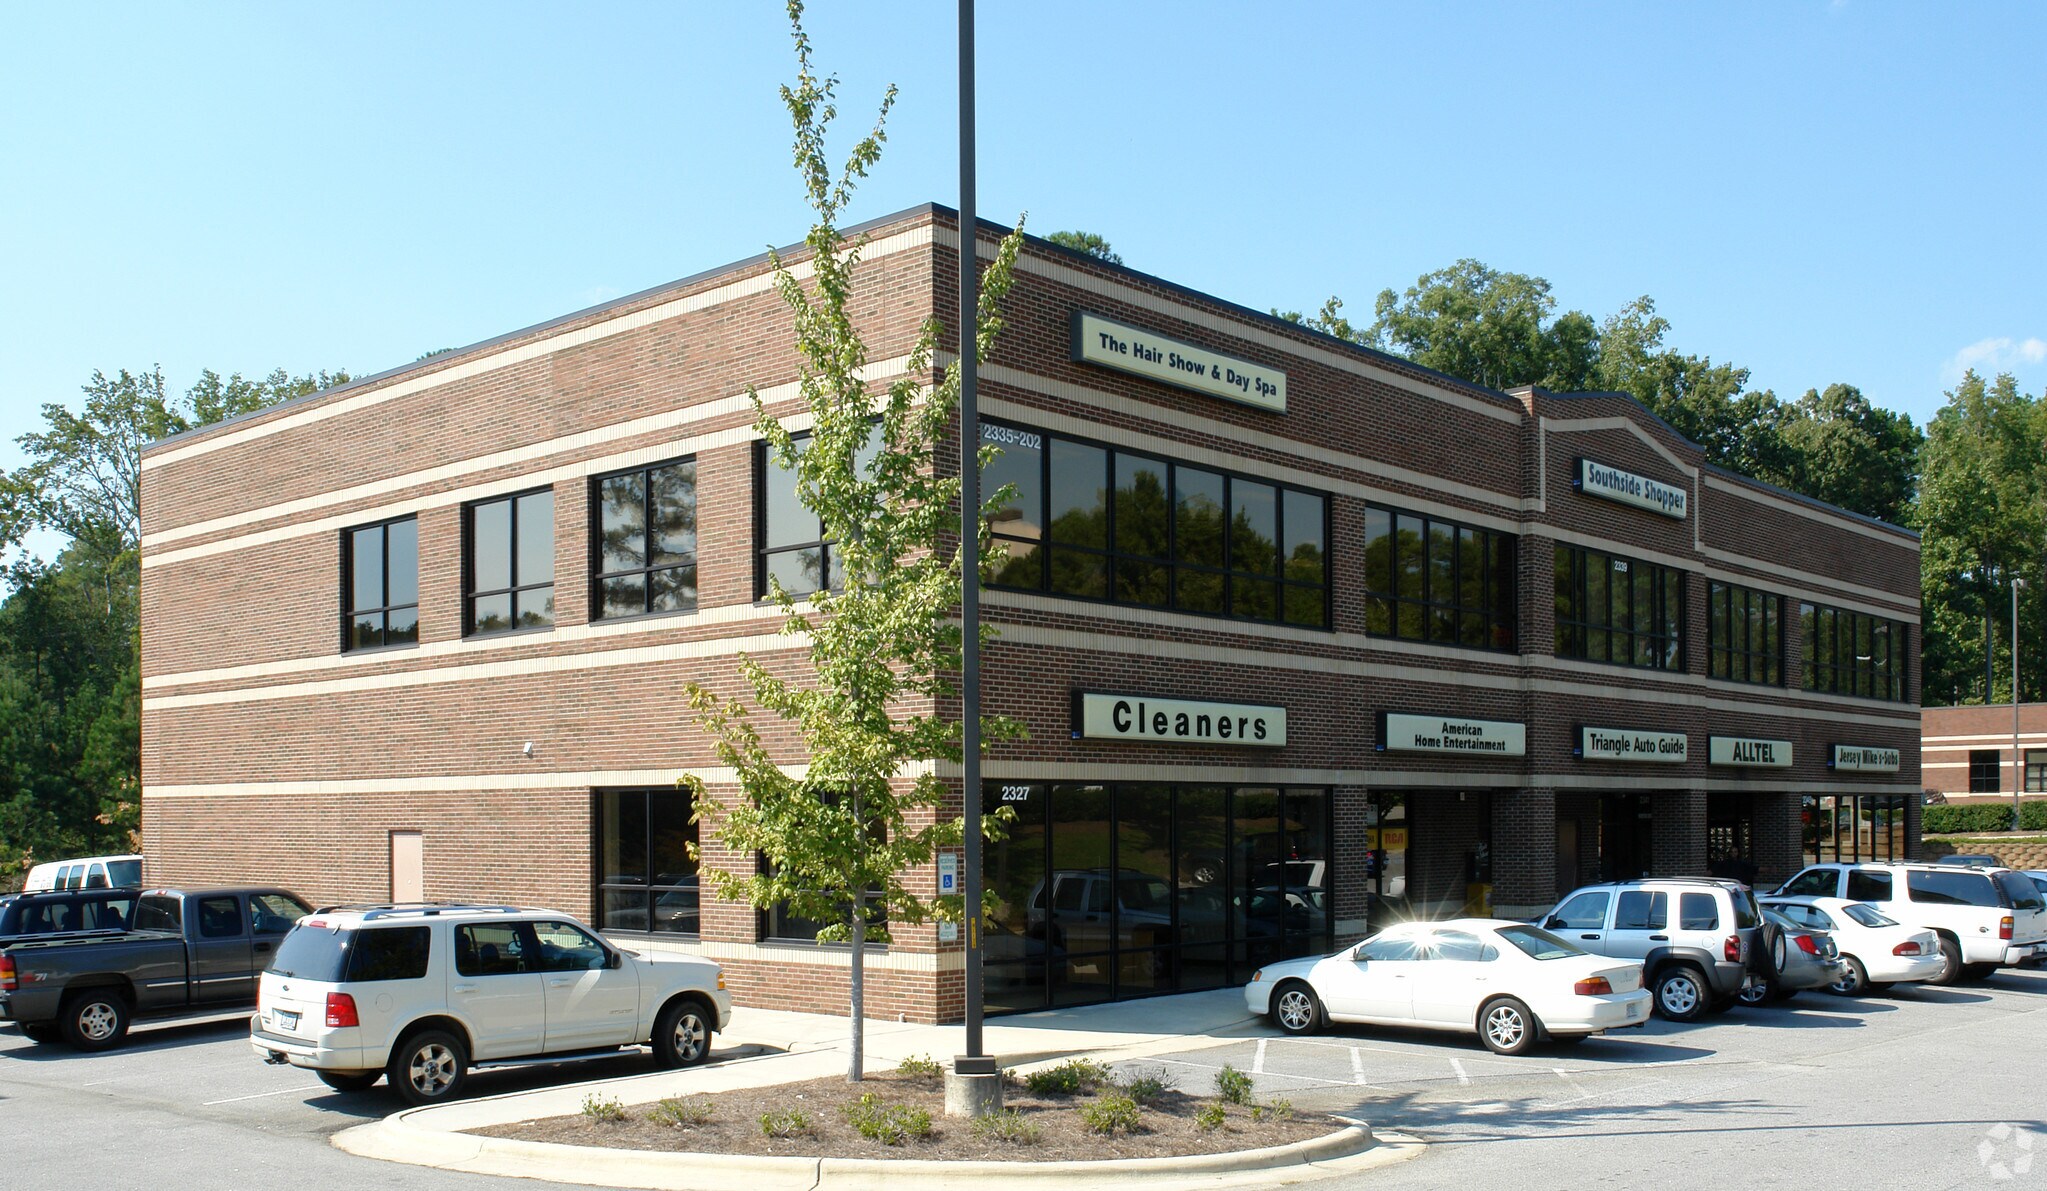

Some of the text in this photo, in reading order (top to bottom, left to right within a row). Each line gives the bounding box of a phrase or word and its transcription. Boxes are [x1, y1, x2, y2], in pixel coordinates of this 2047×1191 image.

[1099, 332, 1277, 397] The Hair Show & Day Spa
[983, 424, 1041, 450] 2335-202
[1589, 464, 1684, 511] Southside Shopper
[1112, 700, 1267, 740] Cleaners
[1442, 722, 1483, 736] American
[1415, 734, 1506, 751] Home Entertainment
[1590, 733, 1685, 756] Triangle Auto Guide
[1733, 741, 1776, 763] ALLTEL
[1839, 748, 1861, 768] Jersey
[1001, 786, 1030, 801] 2327
